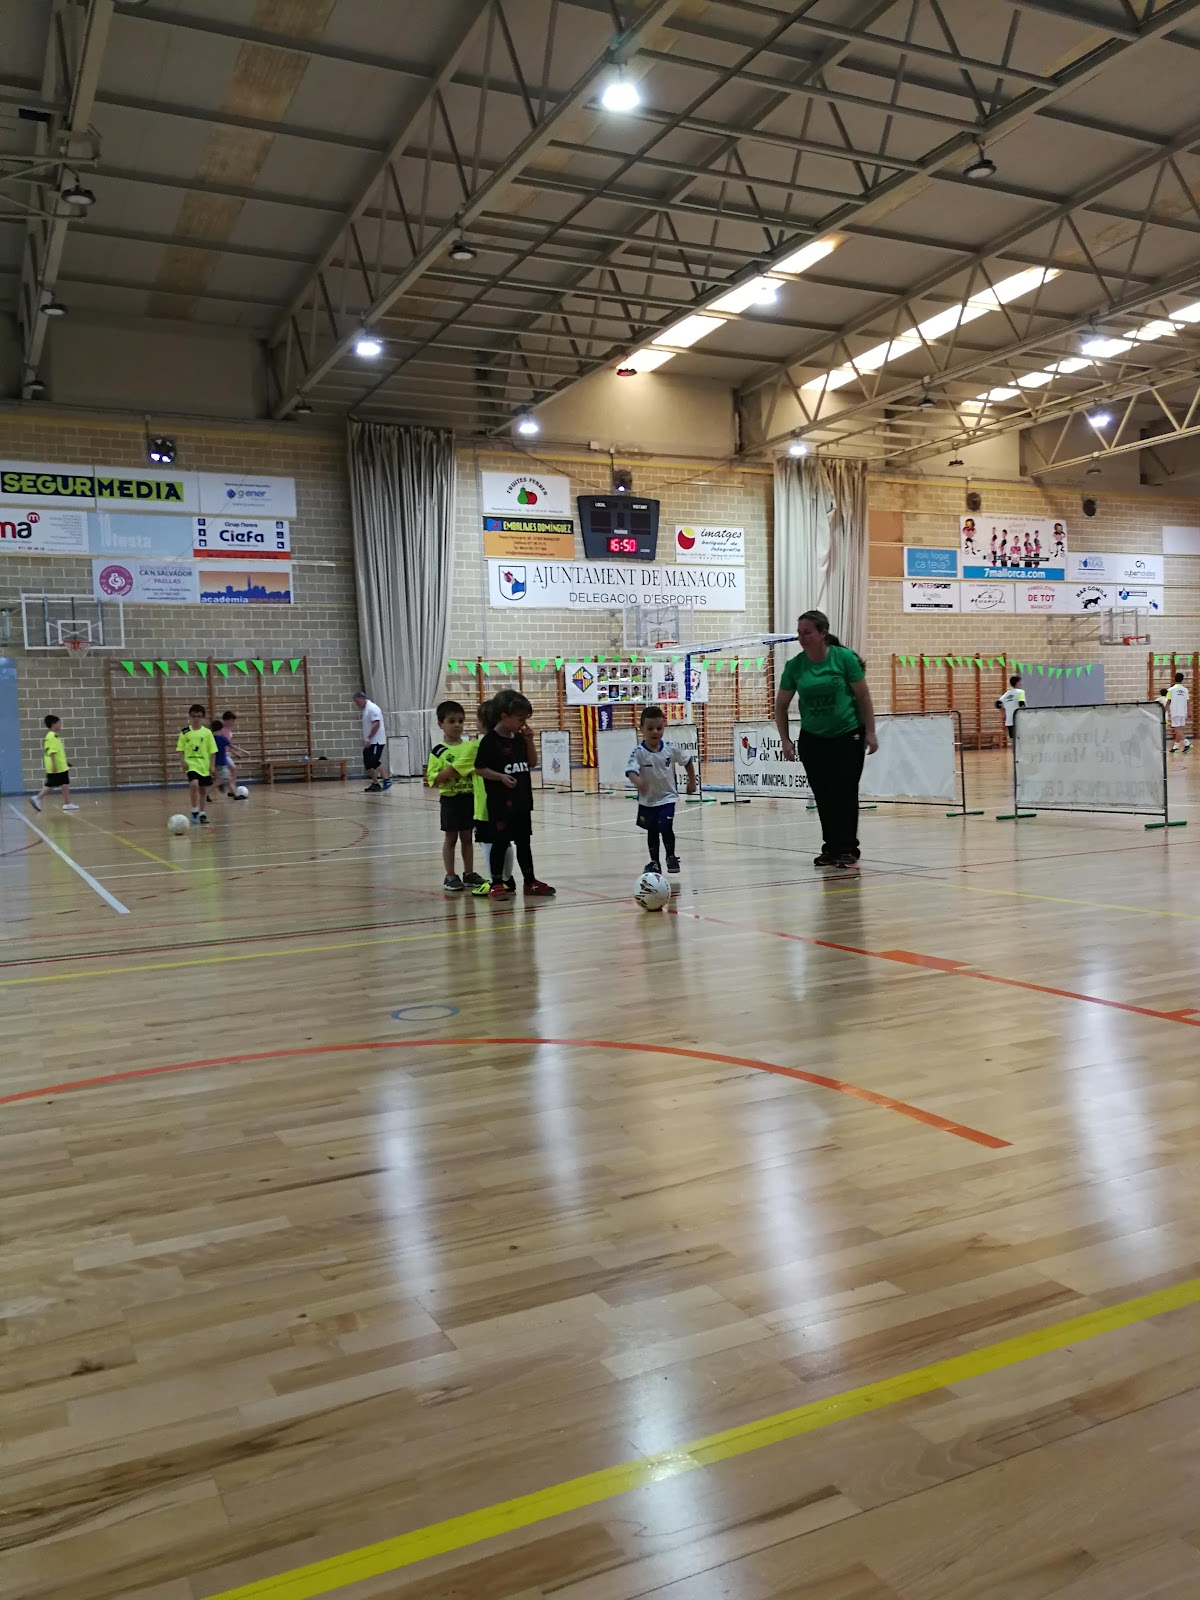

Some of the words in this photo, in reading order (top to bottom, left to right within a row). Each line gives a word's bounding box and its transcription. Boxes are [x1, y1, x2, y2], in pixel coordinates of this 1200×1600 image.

[701, 529, 742, 542] imatges
[532, 565, 637, 590] AJUNTAMENT
[641, 569, 661, 587] DE
[664, 570, 737, 589] MANACOR
[983, 568, 1046, 578] 7mallorca.com
[643, 593, 707, 606] D'ESPORTS
[1028, 594, 1038, 602] DE
[1040, 594, 1055, 602] TOT
[759, 750, 770, 762] de
